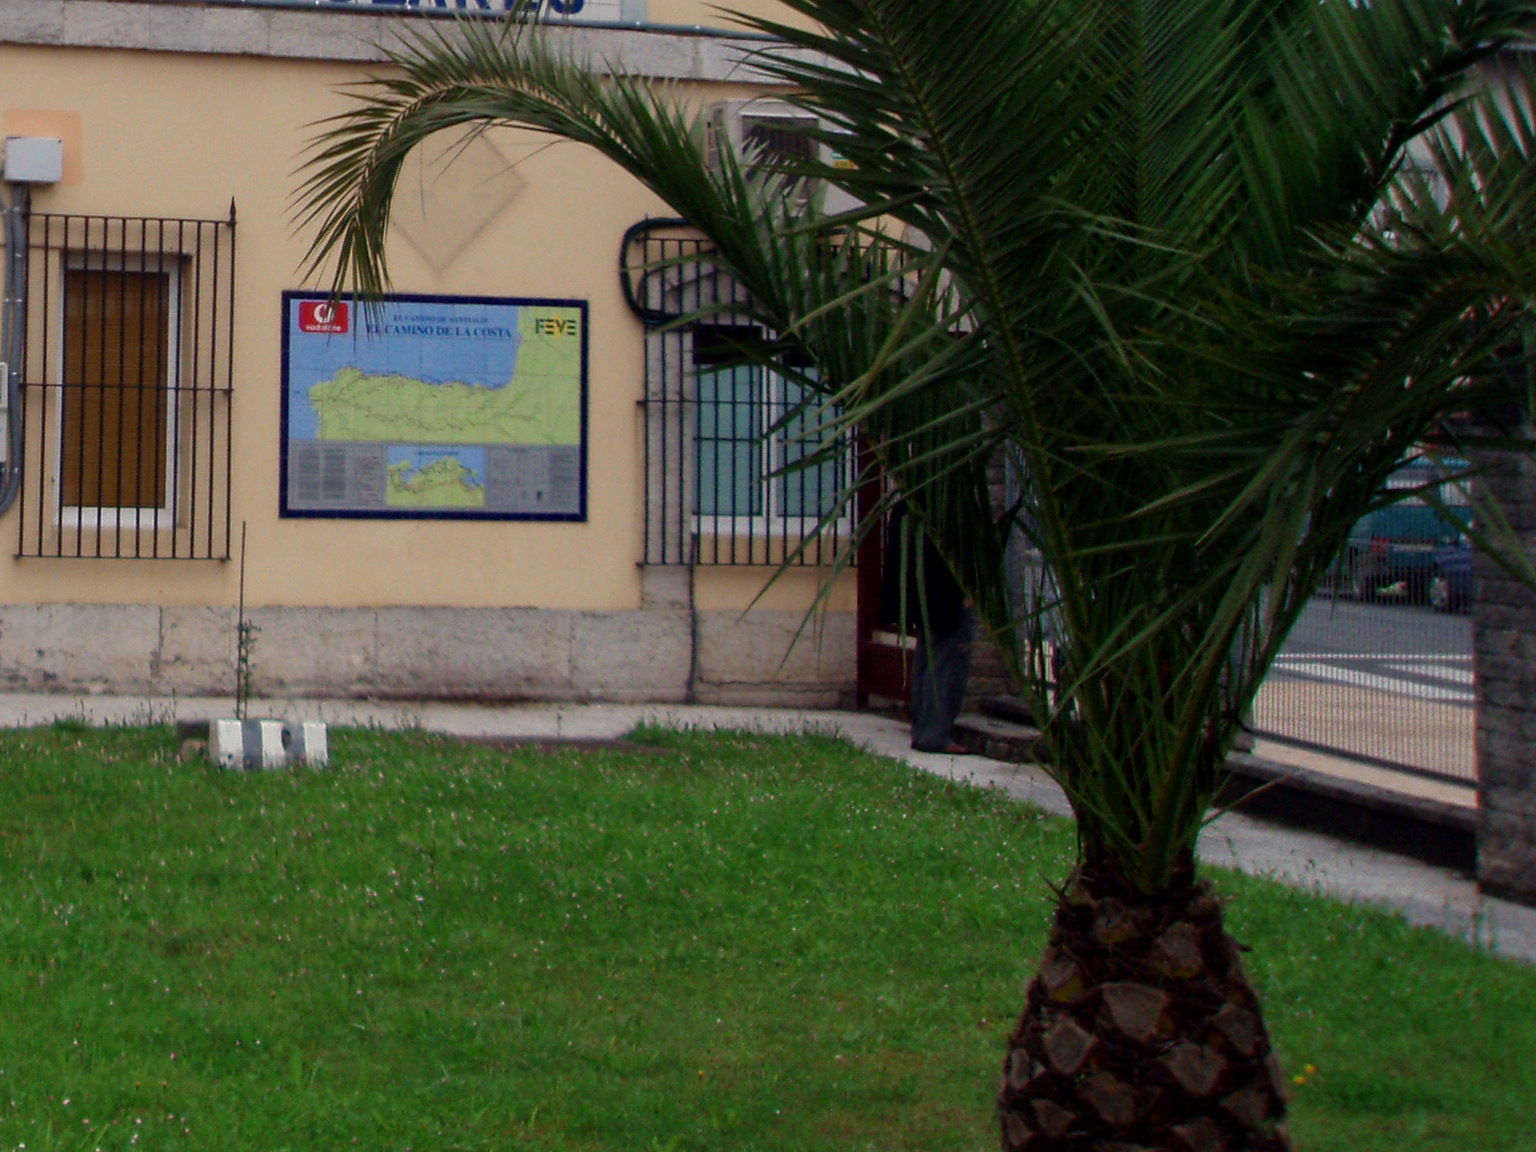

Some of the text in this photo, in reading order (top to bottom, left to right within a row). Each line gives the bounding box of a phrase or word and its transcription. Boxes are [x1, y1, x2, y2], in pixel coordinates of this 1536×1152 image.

[384, 325, 434, 335] CAMINO
[436, 326, 451, 336] DE
[455, 327, 471, 337] LA
[473, 327, 513, 338] COSTA
[535, 318, 576, 335] FEVE
